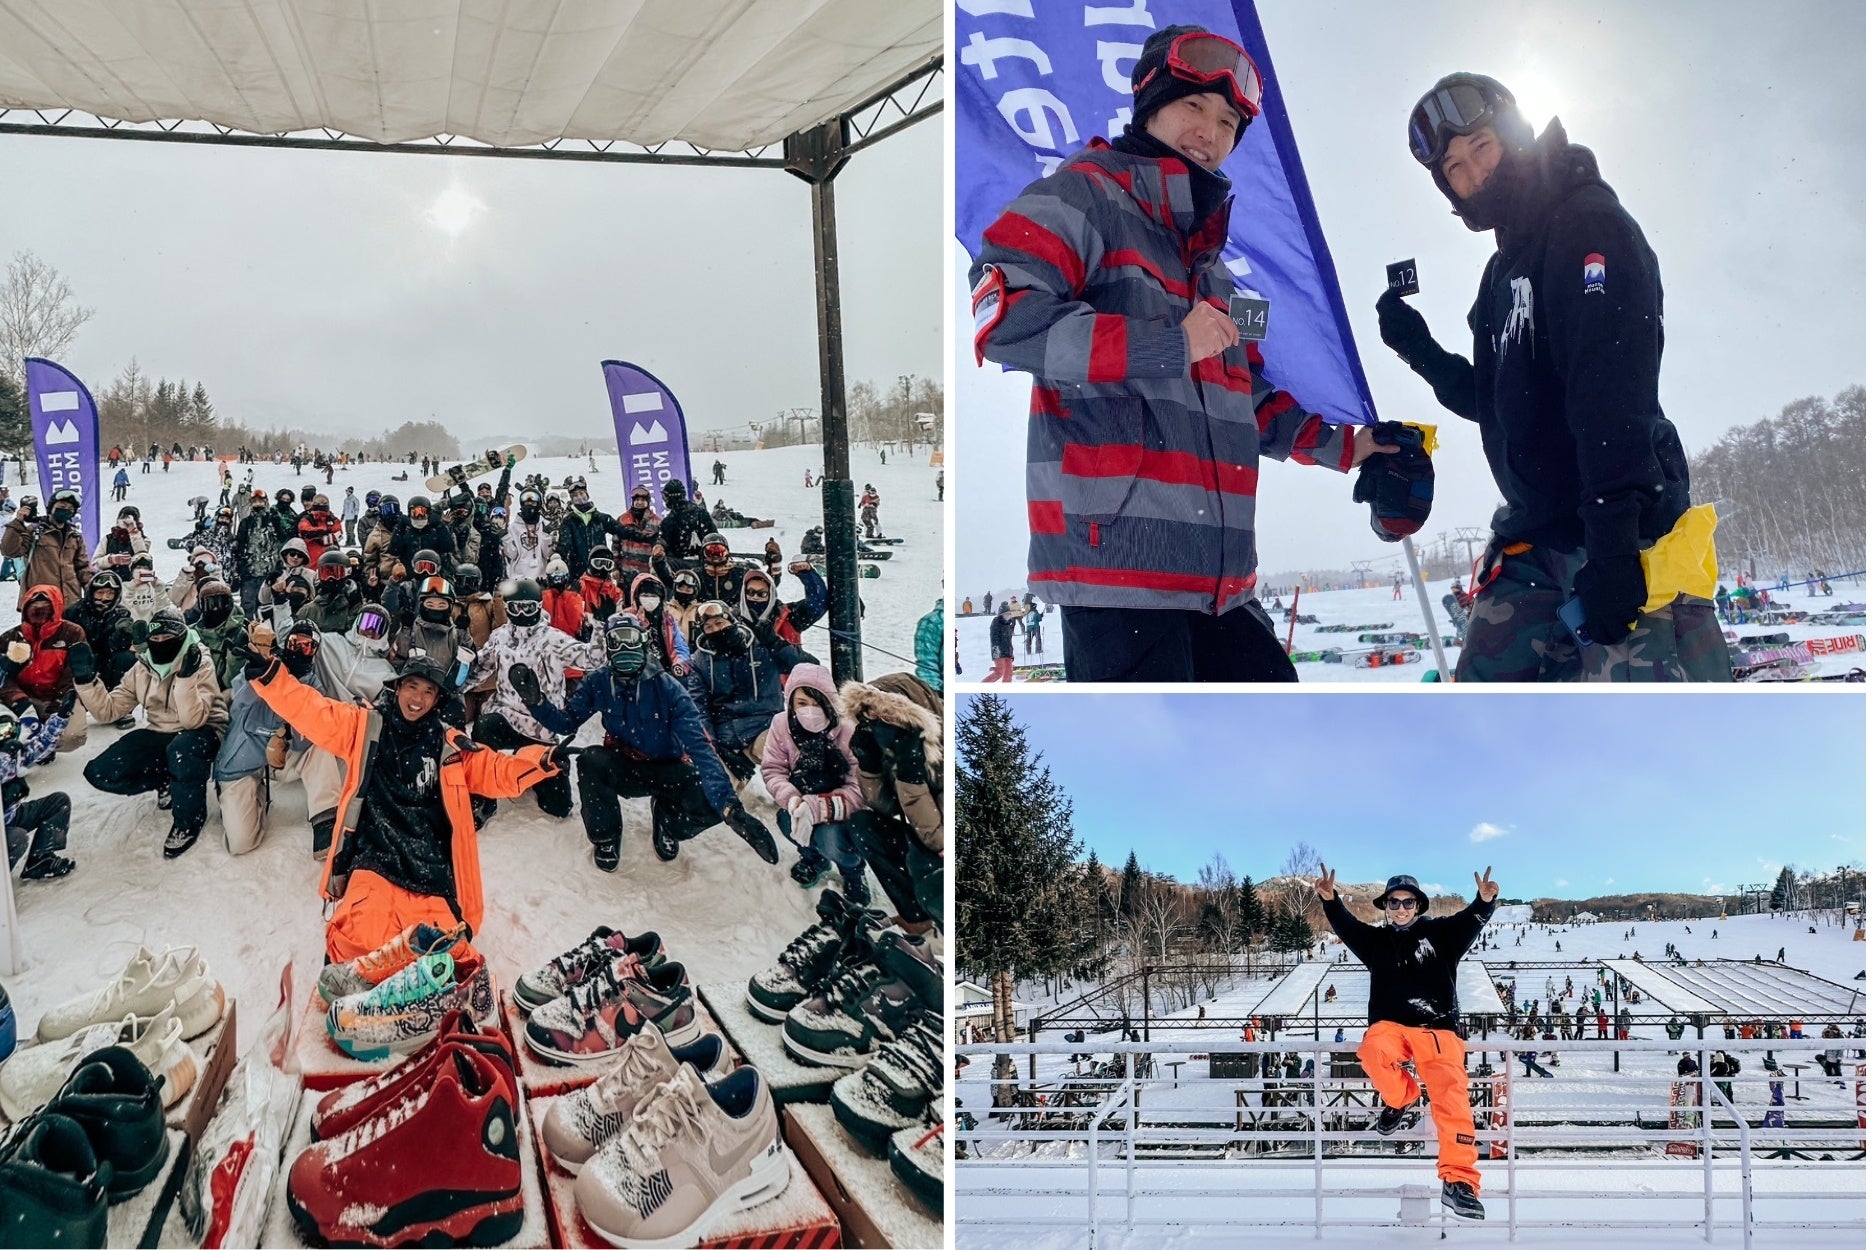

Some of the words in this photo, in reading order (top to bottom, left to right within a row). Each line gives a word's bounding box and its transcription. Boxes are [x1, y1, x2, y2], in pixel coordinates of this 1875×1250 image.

[1390, 268, 1416, 288] NO.12
[1232, 309, 1265, 328] NO.14
[1824, 635, 1856, 653] RIDE
